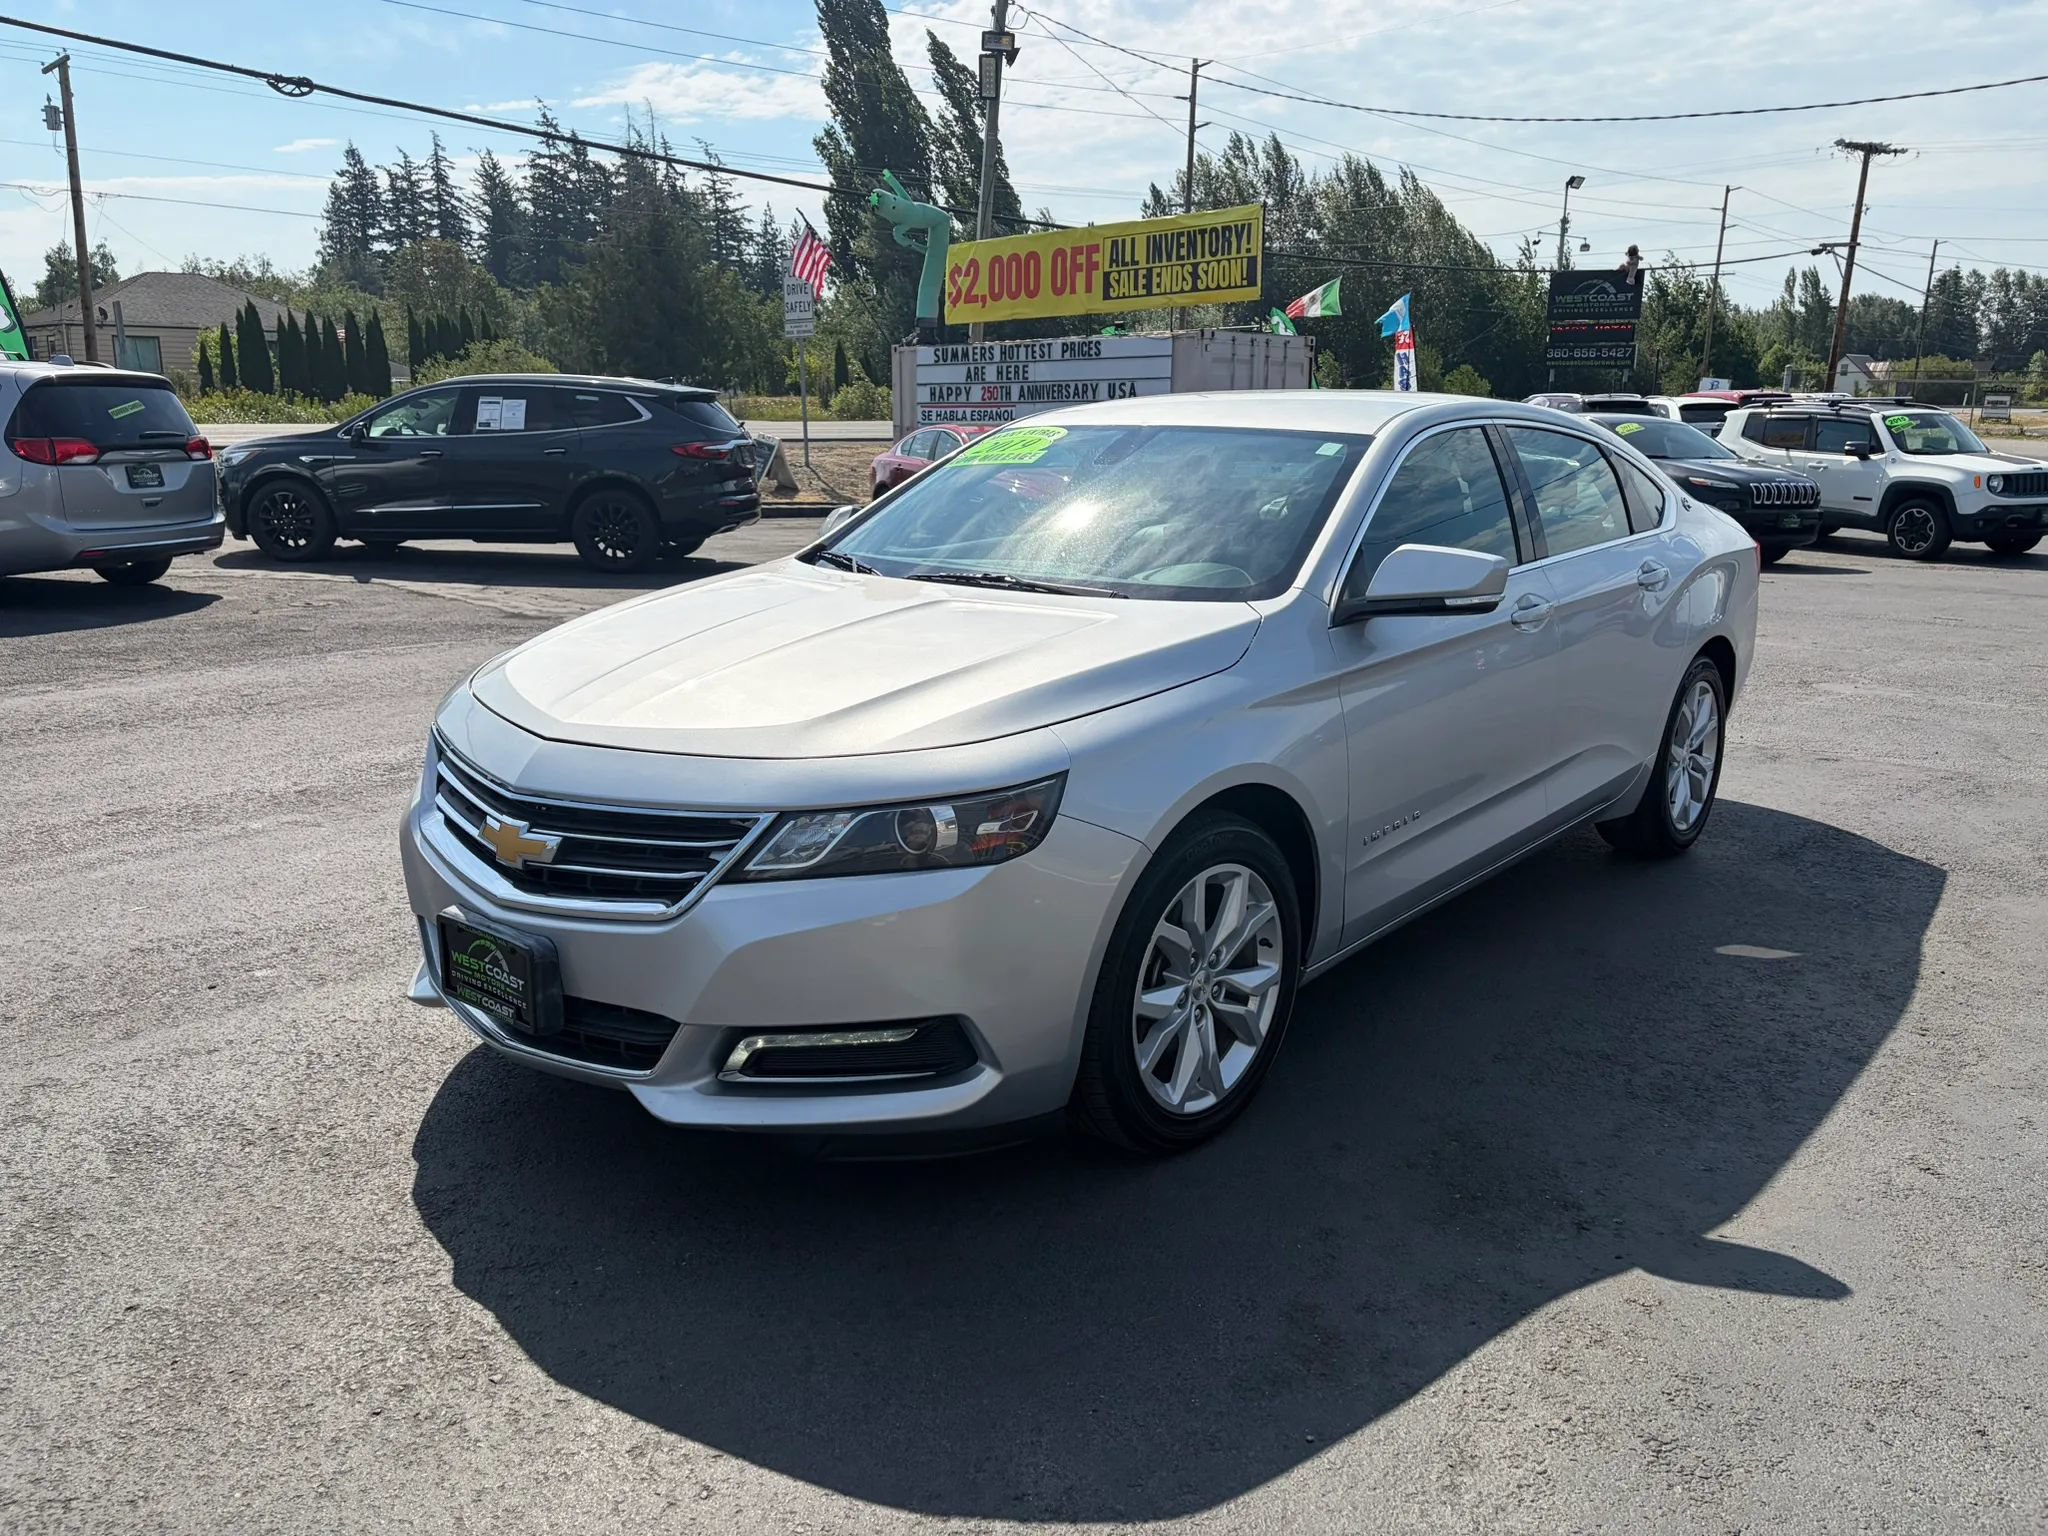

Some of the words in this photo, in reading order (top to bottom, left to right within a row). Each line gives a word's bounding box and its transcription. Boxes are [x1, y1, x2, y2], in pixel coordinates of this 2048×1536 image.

[1109, 237, 1139, 268] ALL
[1146, 223, 1252, 265] INVENTORY!
[948, 250, 1041, 308] $2,000
[1051, 244, 1100, 296] OFF
[1109, 269, 1146, 298] SALE
[1152, 264, 1192, 294] ENDS
[1197, 258, 1248, 290] SOON!
[786, 283, 809, 296] DRIVE
[1554, 292, 1634, 303] WESTCOAST
[785, 301, 811, 313] SAFELY
[934, 345, 994, 364] SUMMERS
[1000, 342, 1052, 361] HOTTEST
[1061, 340, 1101, 358] PRICES
[1546, 348, 1632, 358] 360-656-5427
[965, 366, 986, 382] ARE
[997, 364, 1029, 381] HERE
[929, 385, 972, 402] HAPPY
[981, 385, 1011, 401] 250TH
[1018, 383, 1099, 401] ANNIVERSARY
[1108, 381, 1137, 398] USA
[921, 410, 932, 422] SE
[935, 410, 969, 422] HABLA
[970, 407, 1016, 421] ESPAÑOL
[451, 950, 525, 991] WESTCOAST
[473, 971, 505, 990] MOTORS
[451, 970, 482, 988] DRIVING
[483, 983, 527, 1010] EXCELLENCE
[456, 984, 515, 1018] WESTCOAST
